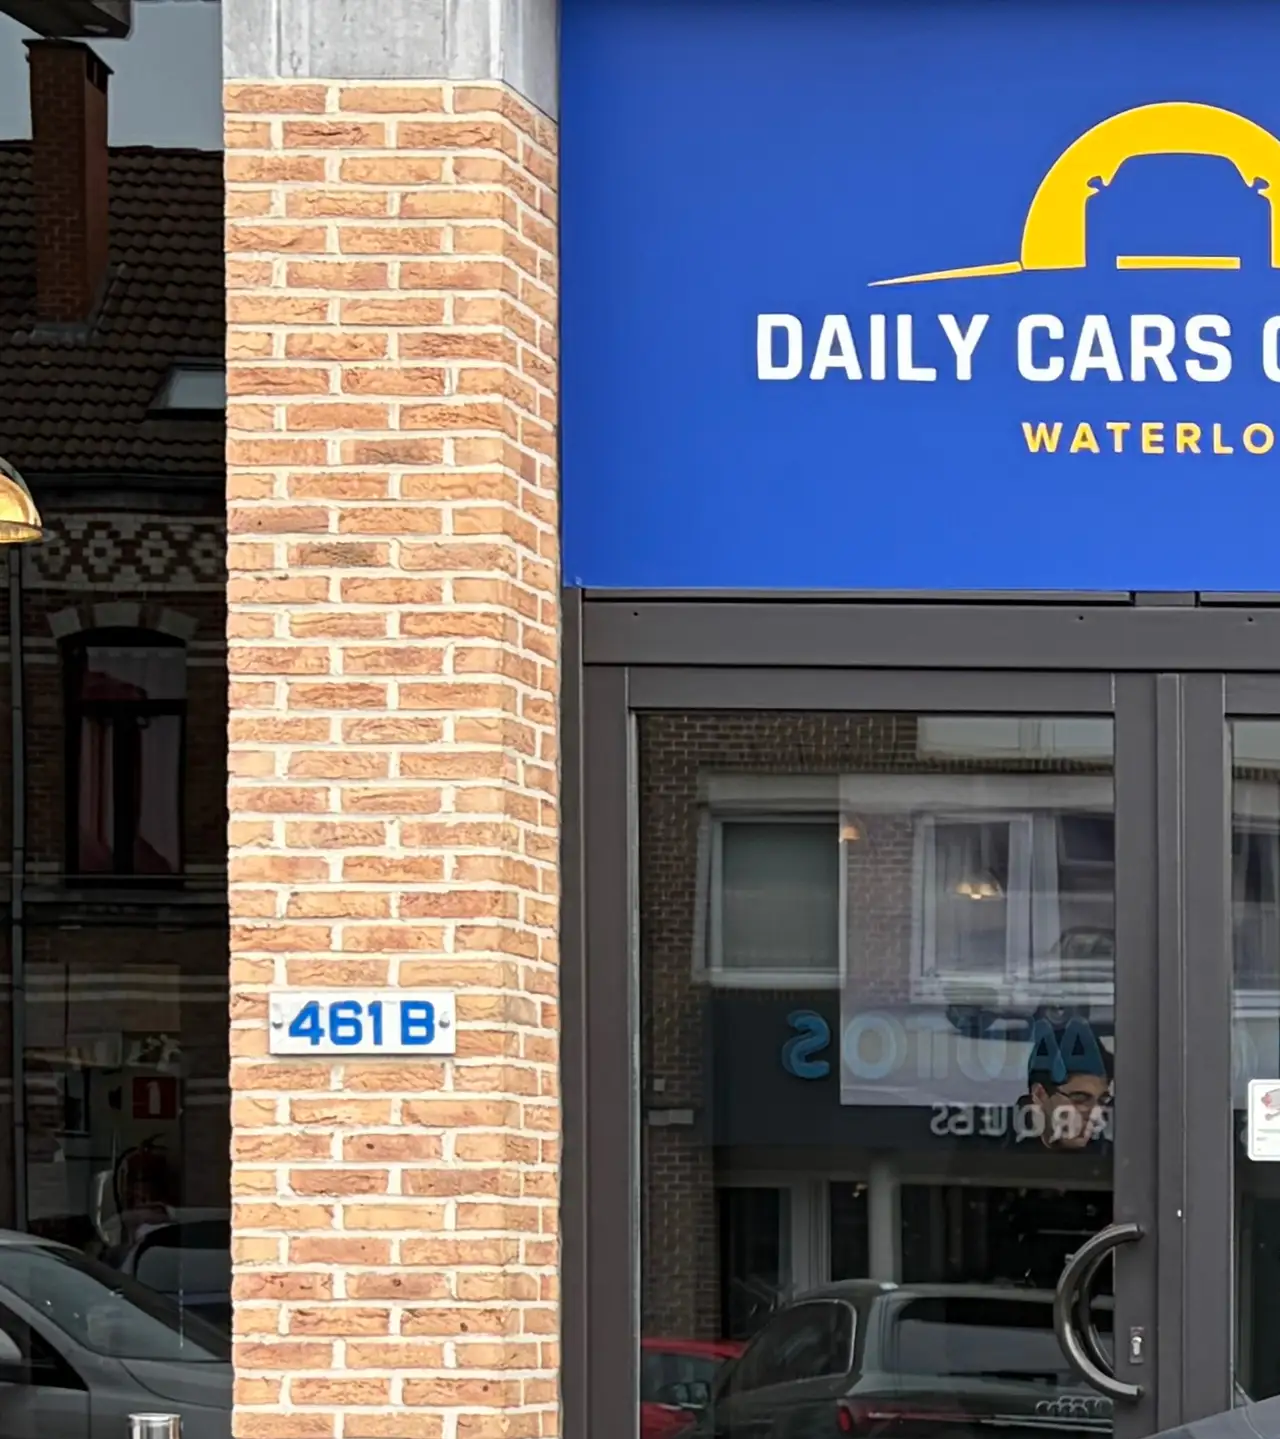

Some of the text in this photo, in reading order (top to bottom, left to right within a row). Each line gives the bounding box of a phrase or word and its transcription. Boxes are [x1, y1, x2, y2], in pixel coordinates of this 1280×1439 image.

[756, 313, 991, 381] DAILY
[1016, 313, 1234, 384] CARS
[288, 1000, 435, 1046] 461 B
